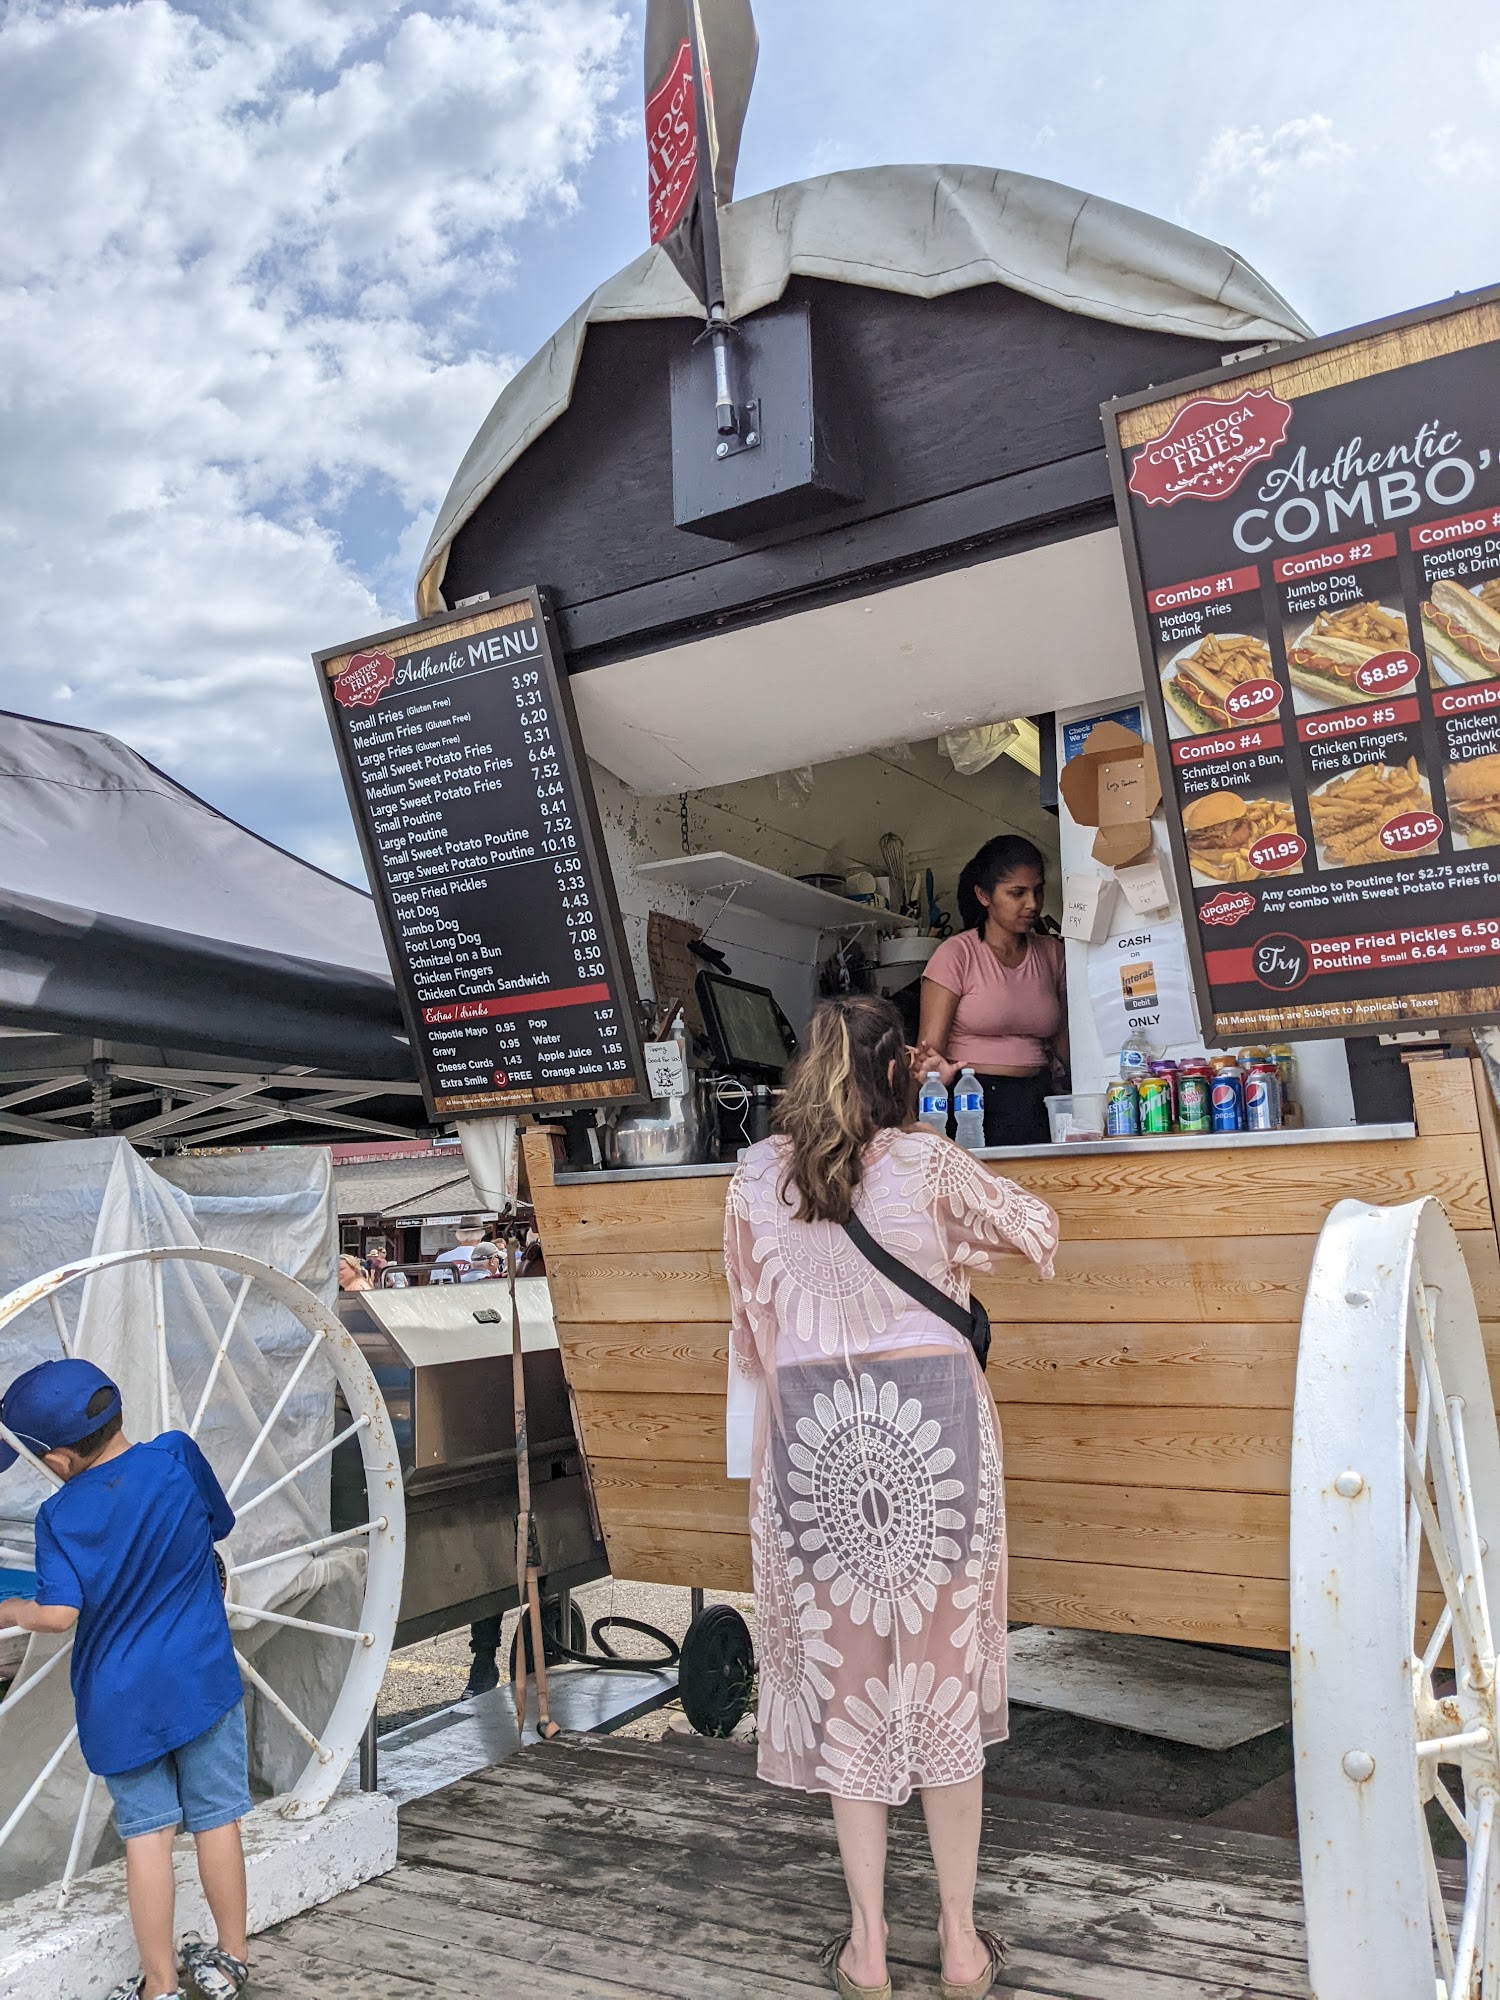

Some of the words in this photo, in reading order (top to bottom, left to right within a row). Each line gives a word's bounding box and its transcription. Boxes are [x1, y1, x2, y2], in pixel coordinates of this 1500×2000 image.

[648, 112, 689, 200] IES
[1149, 406, 1255, 465] CONESTOGA
[1172, 426, 1244, 475] FRIES
[1258, 419, 1462, 502] Authentic
[1232, 448, 1500, 553] COMBO'
[1282, 553, 1343, 575] Combo
[1349, 543, 1372, 560] #2
[1155, 585, 1211, 606] Combo
[1216, 576, 1232, 592] #1
[1286, 581, 1327, 598] Jumbo
[1329, 575, 1355, 588] Dog
[1288, 599, 1315, 612] Fries
[1318, 594, 1327, 605] &
[1330, 586, 1363, 603] Drink
[1159, 611, 1203, 632] Hotdog,
[1205, 603, 1231, 617] Fries
[1161, 630, 1170, 641] &
[1171, 621, 1202, 639] Drink
[395, 651, 465, 686] Authentic
[467, 626, 539, 667] MENU
[341, 659, 380, 686] CONESTOGA
[350, 669, 378, 693] FRIES
[1361, 659, 1407, 685] $8.85
[349, 714, 376, 732] Small
[377, 710, 404, 724] Fries
[406, 704, 431, 716] (Gluten
[432, 696, 450, 708] Free)
[511, 671, 538, 689] 3.99
[1229, 687, 1273, 711] $6.20
[1306, 715, 1367, 735] Combo
[1372, 707, 1394, 723] #5
[361, 765, 388, 783] Small
[389, 759, 423, 776] Sweet
[424, 751, 462, 767] Potato
[464, 743, 492, 758] Fries
[523, 726, 550, 744] 5.31
[1179, 740, 1235, 759] Combo
[1240, 733, 1261, 748] #4
[1182, 761, 1229, 779] Schnitzel
[1232, 761, 1246, 770] on
[1249, 759, 1255, 767] a
[1257, 754, 1283, 765] Bun,
[1184, 781, 1208, 792] Fries
[1211, 777, 1219, 788] &
[1221, 772, 1250, 786] Drink
[374, 816, 401, 833] Small
[402, 810, 442, 827] Poutine
[537, 781, 564, 797] 6.64
[378, 837, 406, 850] Large
[407, 827, 447, 843] Poutine
[540, 799, 566, 815] 8.41
[1383, 819, 1436, 845] $13.05
[386, 870, 414, 883] Large
[416, 861, 449, 877] Sweet
[450, 855, 487, 870] Potato
[490, 846, 534, 863] Poutine
[541, 834, 575, 852] 10.18
[1253, 841, 1298, 864] $11.95
[392, 892, 419, 904] Deep
[420, 882, 448, 898] Fried
[449, 877, 487, 893] Pickles
[554, 857, 581, 873] 6.50
[1261, 891, 1283, 900] Any
[1287, 884, 1327, 896] combo
[1330, 882, 1343, 891] to
[1346, 876, 1393, 889] Poutine
[1396, 872, 1414, 882] for
[1418, 865, 1452, 879] $2.75
[1456, 862, 1489, 873] extra
[396, 908, 416, 920] Hot
[416, 905, 439, 917] Dog
[557, 875, 585, 891] 3.33
[1203, 897, 1250, 918] UPGRADE
[402, 922, 434, 936] Jumbo
[435, 919, 459, 931] Dog
[562, 893, 588, 908] 4.43
[1069, 916, 1081, 927] FRY
[409, 951, 453, 969] Schnitzel
[455, 952, 469, 962] on
[471, 951, 478, 959] a
[480, 946, 501, 958] Bun
[569, 928, 596, 943] 7.08
[1118, 934, 1152, 949] CASH
[1310, 941, 1350, 954] Deep
[1355, 933, 1395, 949] Fried
[1400, 928, 1456, 943] Pickles
[1461, 921, 1498, 936] 6.50
[413, 970, 452, 984] Chicken
[454, 966, 493, 980] Fingers
[574, 945, 600, 961] 8.50
[1259, 946, 1300, 984] Try
[1313, 954, 1371, 969] Poutine
[1380, 952, 1407, 962] Small
[1411, 943, 1447, 958] 6.64
[1457, 944, 1486, 953] Large
[417, 987, 456, 1001] Chicken
[458, 979, 495, 995] Crunch
[497, 971, 550, 990] Sandwich
[577, 963, 604, 978] 8.50
[1122, 968, 1153, 987] Interac
[426, 1008, 452, 1023] Extras
[460, 1003, 489, 1019] drinks
[1133, 999, 1151, 1007] Debit
[1216, 1017, 1227, 1025] All
[1304, 1008, 1339, 1017] Subject
[1355, 1000, 1407, 1013] Applicable
[1410, 999, 1438, 1007] Taxes
[528, 1019, 547, 1028] Pop
[594, 1008, 613, 1019] 1.67
[1128, 1014, 1160, 1028] ONLY
[428, 1029, 463, 1041] Chipotle
[464, 1027, 488, 1036] Mayo
[495, 1022, 515, 1032] 0.95
[532, 1034, 560, 1044] Water
[598, 1025, 617, 1036] 1.67
[432, 1047, 455, 1056] Gravy
[499, 1038, 520, 1048] 0.95
[538, 1050, 565, 1062] Apple
[567, 1047, 592, 1058] Juice
[602, 1043, 622, 1053] 1.85
[436, 1063, 466, 1072] Cheese
[468, 1058, 493, 1068] Curds
[503, 1055, 522, 1065] 1.43
[541, 1067, 575, 1077] Orange
[578, 1063, 602, 1074] Juice
[606, 1059, 626, 1070] 1.85
[440, 1079, 463, 1087] Extra
[464, 1075, 487, 1085] Smile
[508, 1070, 532, 1081] FREE
